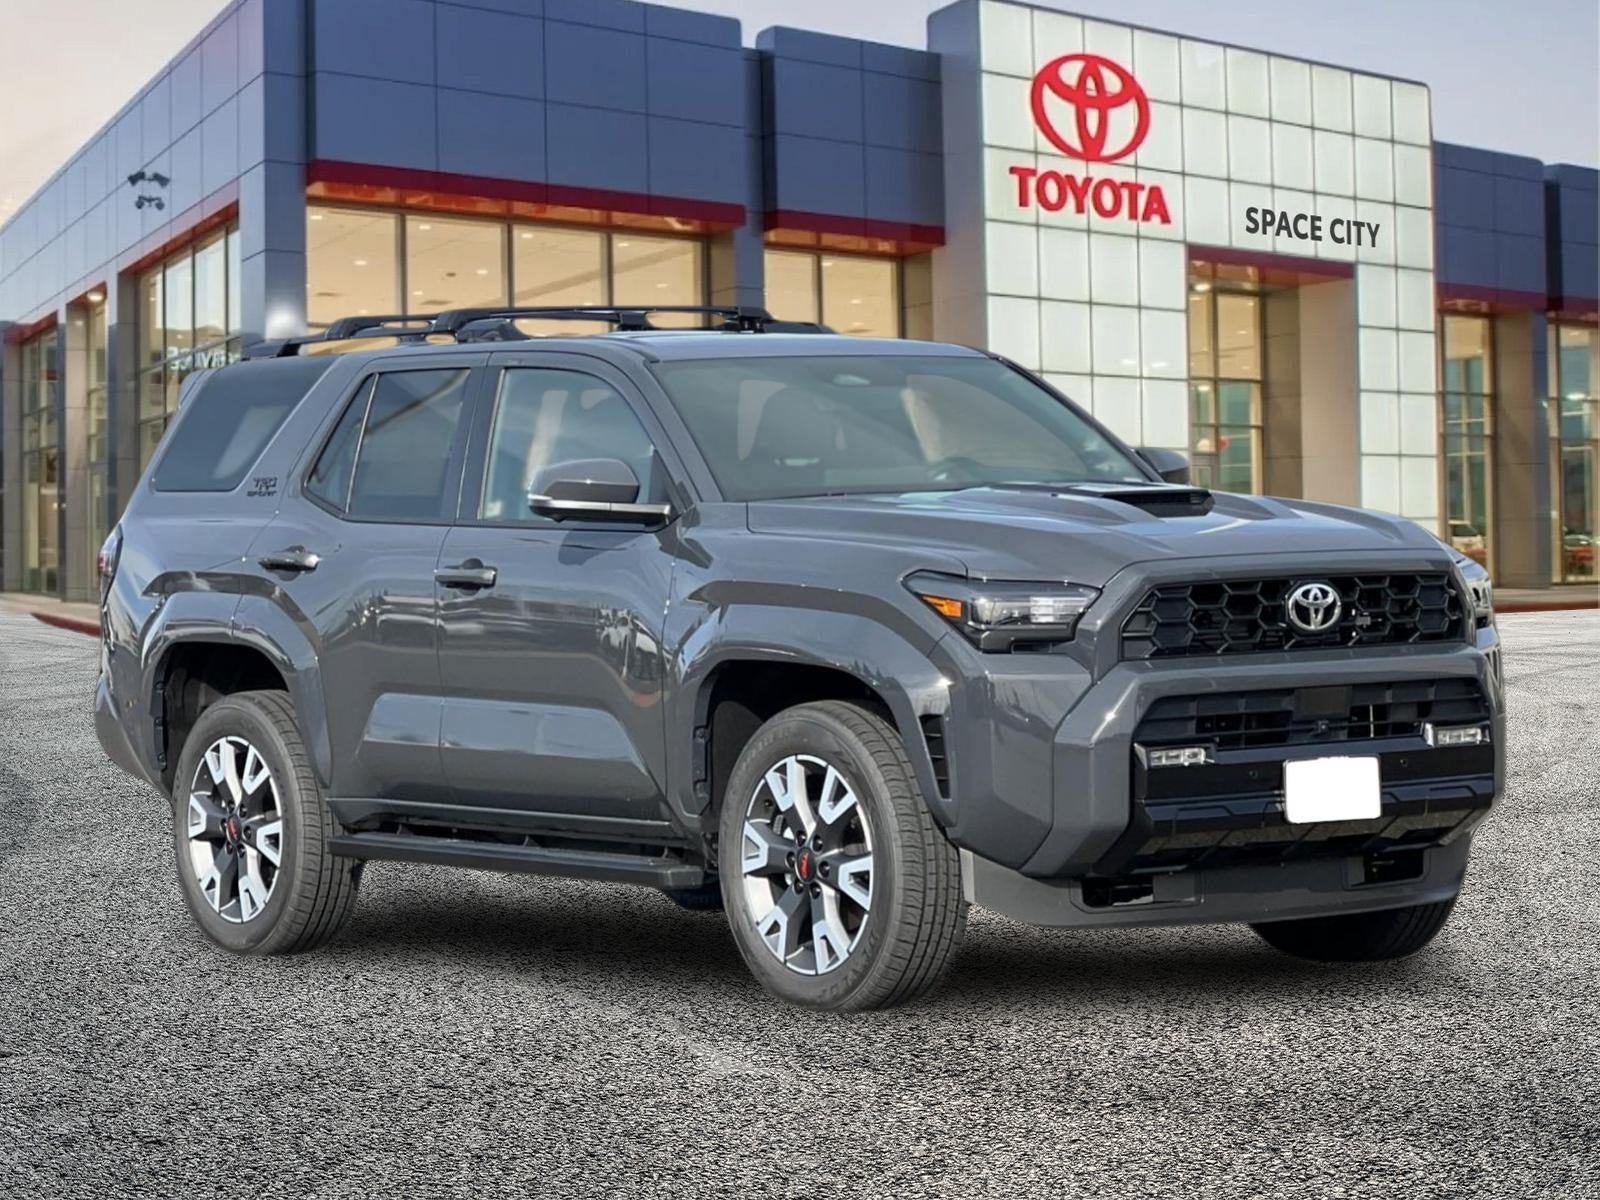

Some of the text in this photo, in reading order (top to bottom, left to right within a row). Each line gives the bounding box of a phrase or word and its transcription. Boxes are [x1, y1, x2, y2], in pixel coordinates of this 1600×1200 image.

[1009, 166, 1172, 225] TOYOTA
[1245, 206, 1381, 248] SPACE CITY
